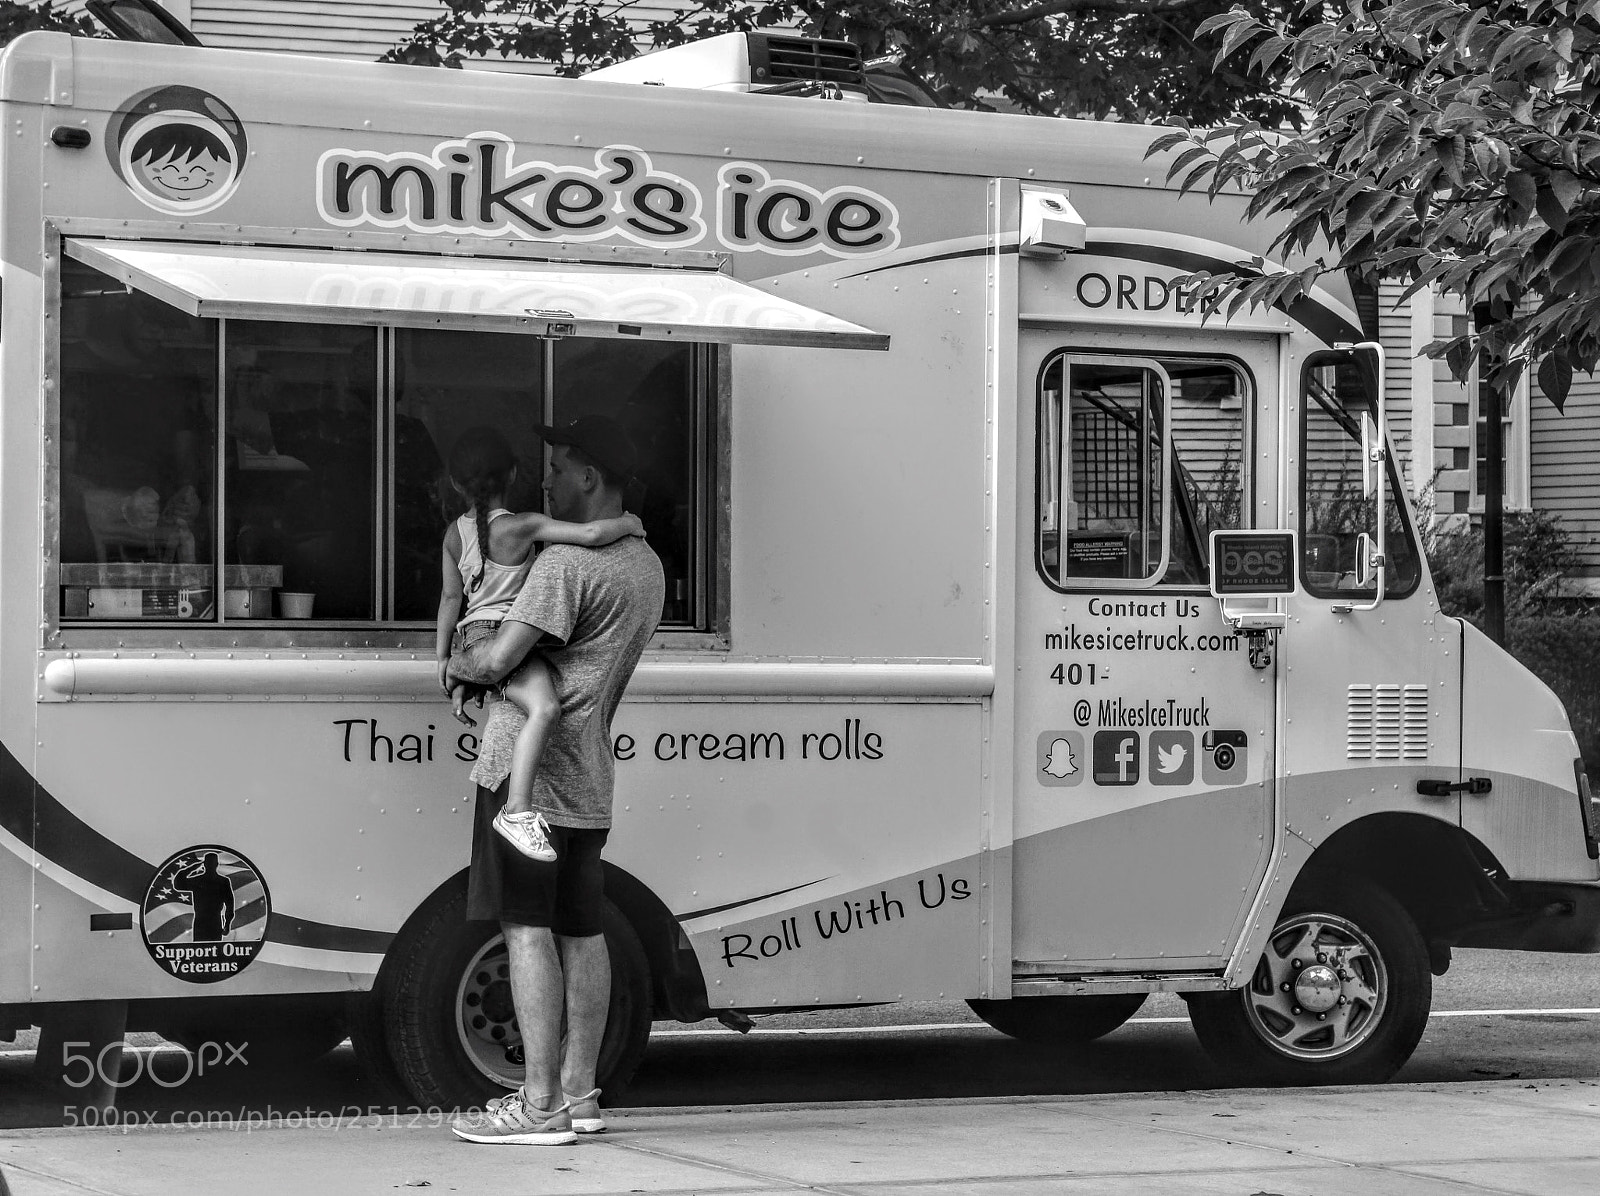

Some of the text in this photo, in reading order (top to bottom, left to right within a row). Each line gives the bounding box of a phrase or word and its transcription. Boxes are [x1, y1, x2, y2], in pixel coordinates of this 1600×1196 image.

[337, 144, 884, 247] mike's ice
[1221, 543, 1288, 576] bes
[1088, 597, 1201, 618] Contact Us
[1045, 624, 1239, 652] mikesicetruck.com
[1050, 663, 1109, 686] 401-
[1097, 697, 1210, 728] MikesIceTruck
[332, 718, 436, 764] Thai
[654, 732, 785, 762] cream
[802, 718, 884, 761] rolls
[720, 873, 972, 968] Roll With Us
[155, 943, 253, 960] Support Our
[169, 960, 238, 974] Veterans
